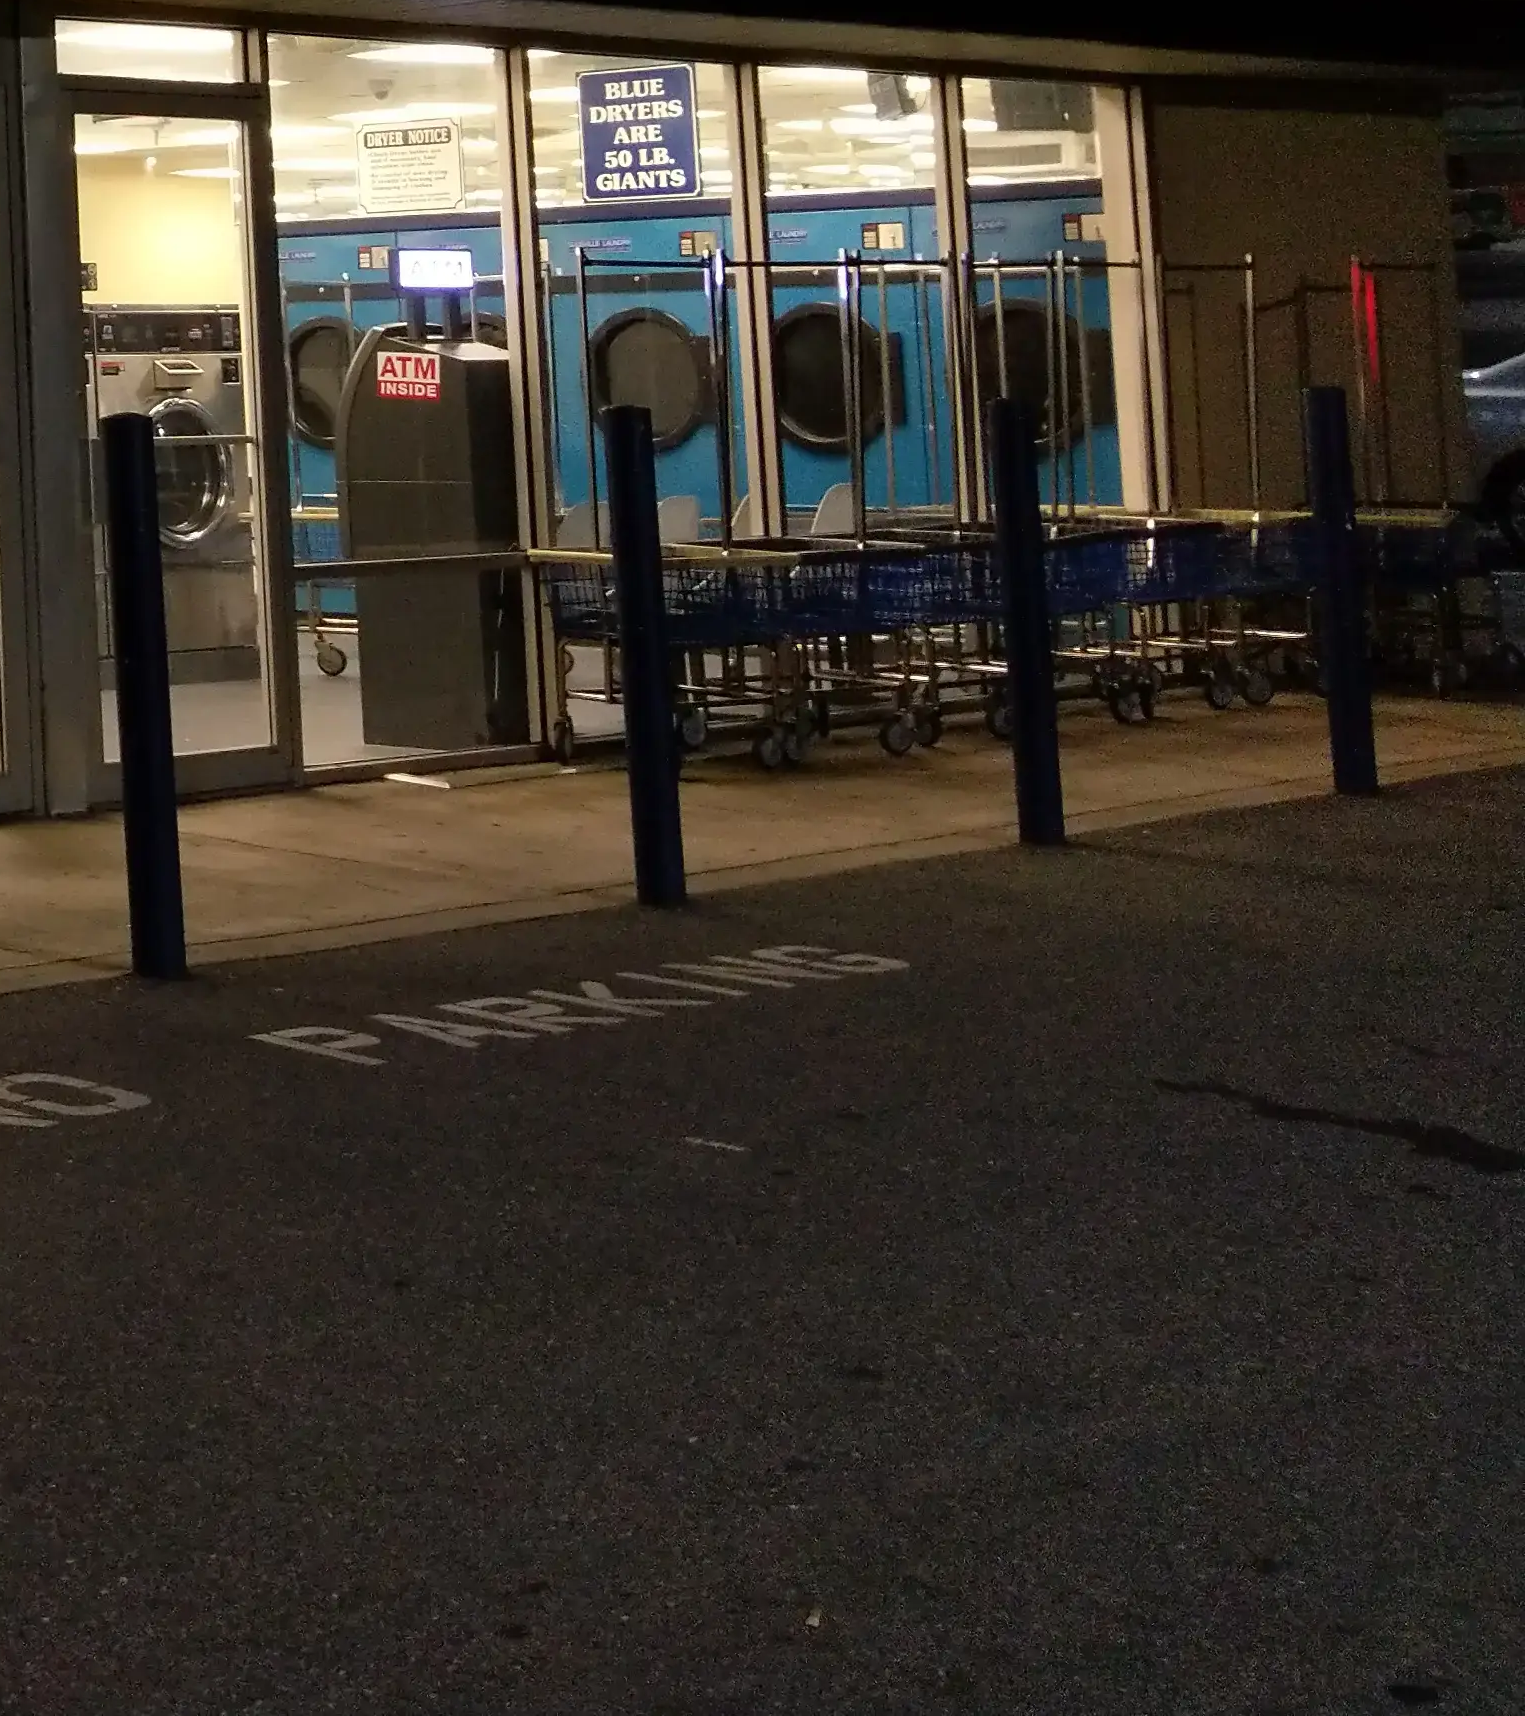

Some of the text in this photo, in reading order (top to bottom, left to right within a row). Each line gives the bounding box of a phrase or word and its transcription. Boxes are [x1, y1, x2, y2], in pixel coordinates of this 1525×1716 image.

[604, 78, 666, 100] BLUE
[589, 99, 685, 124] DRYERS
[366, 128, 449, 147] DRYER NOTICE
[613, 124, 663, 145] ARE
[604, 147, 676, 169] 50 LB.
[595, 168, 688, 192] GIANTS
[379, 355, 437, 381] ATM
[379, 382, 437, 398] INSIDE
[248, 943, 910, 1067] PARKING
